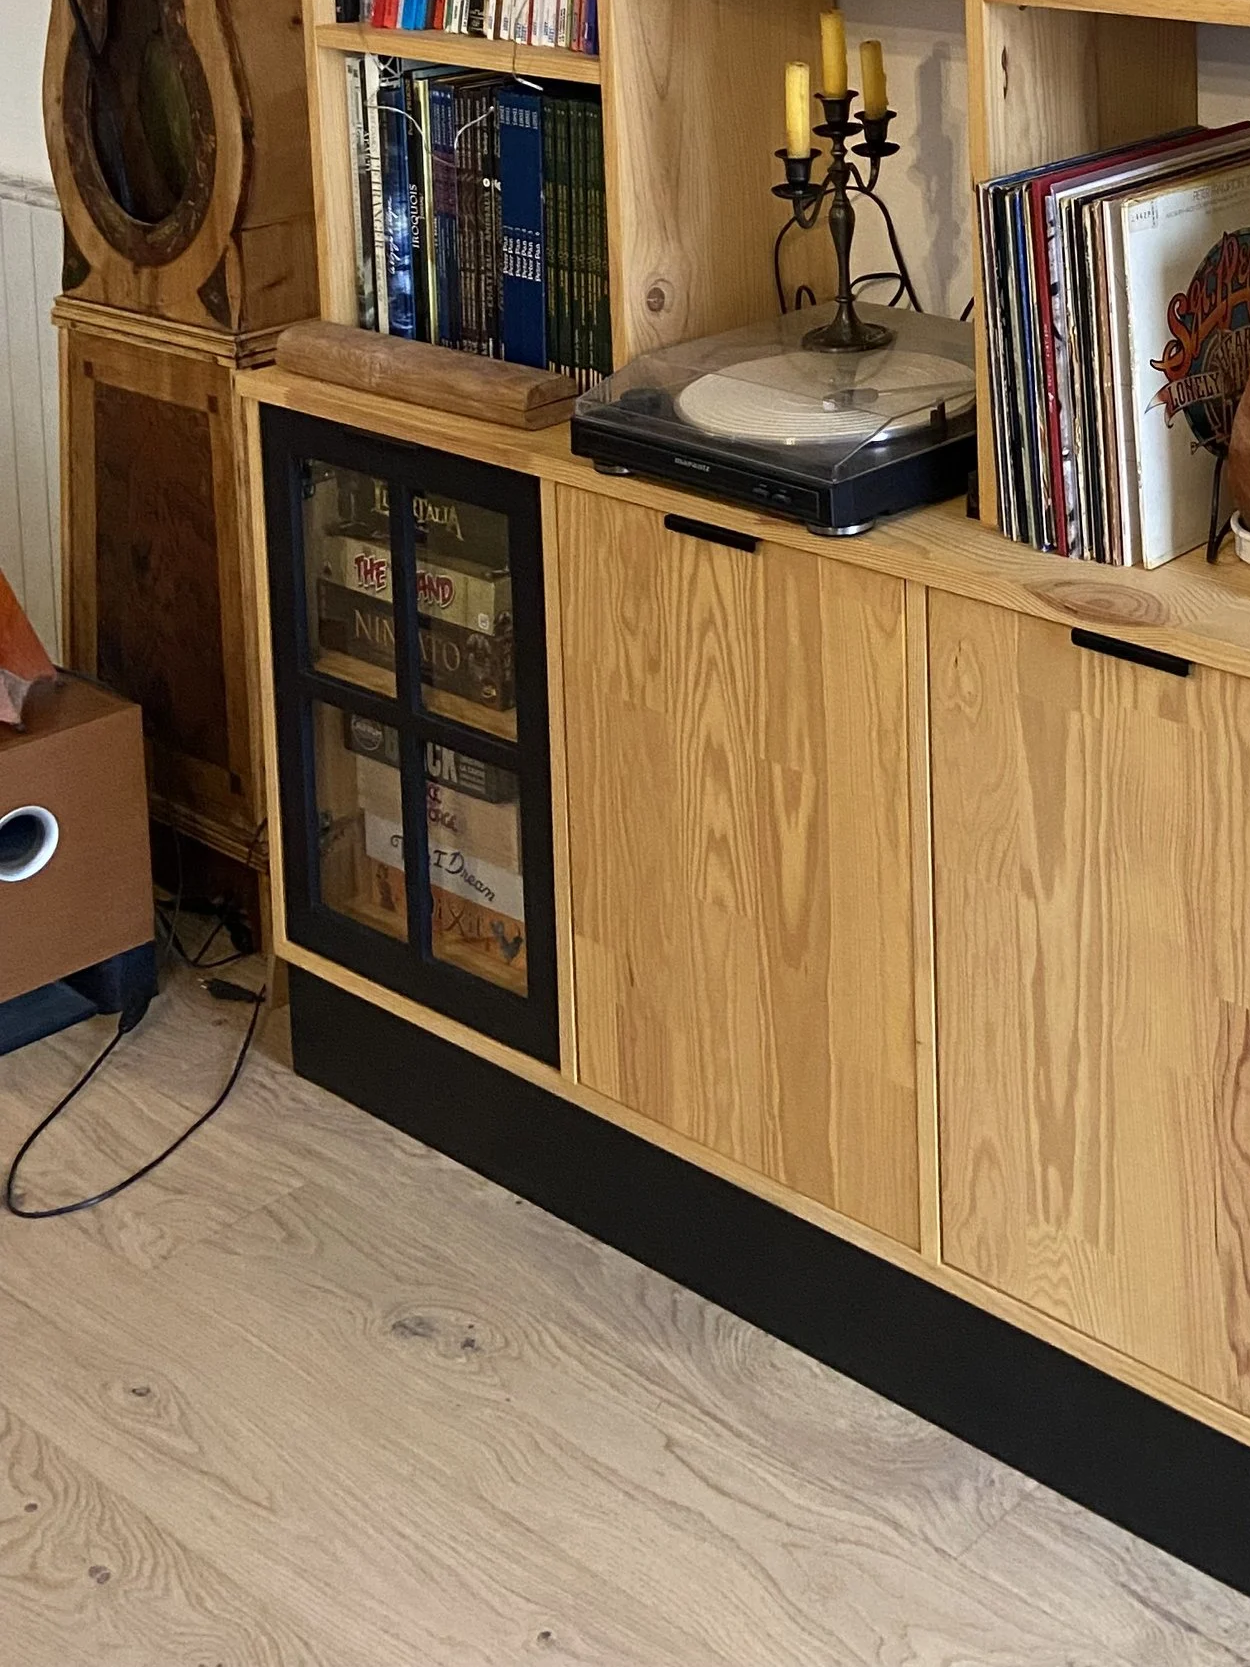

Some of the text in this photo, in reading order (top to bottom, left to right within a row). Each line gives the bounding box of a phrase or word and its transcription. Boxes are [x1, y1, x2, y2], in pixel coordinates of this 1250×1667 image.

[410, 183, 421, 249] IROQUOIS
[1167, 372, 1221, 407] LONELY
[674, 457, 711, 472] marantz
[354, 556, 387, 591] THE
[450, 852, 496, 903] Dream
